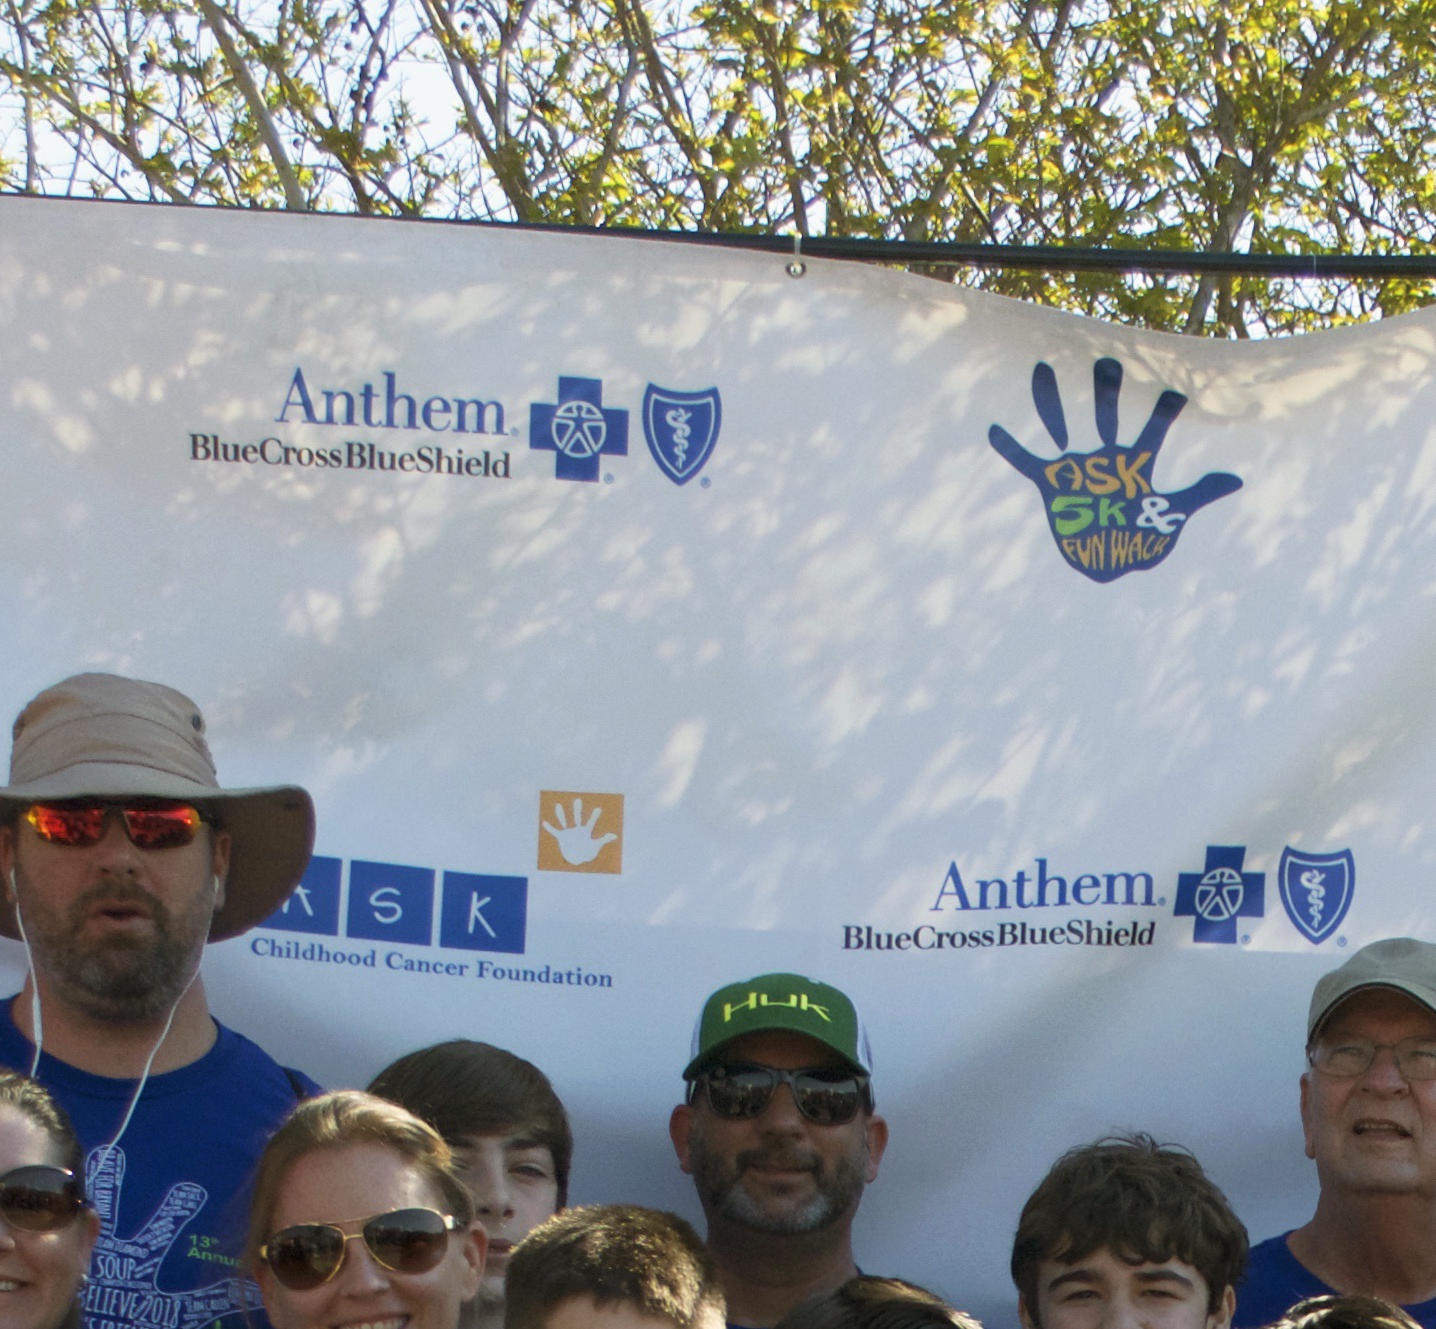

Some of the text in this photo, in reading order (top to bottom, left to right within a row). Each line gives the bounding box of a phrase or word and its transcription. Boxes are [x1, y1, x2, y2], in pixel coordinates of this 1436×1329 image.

[274, 366, 509, 436] Anthem
[1044, 451, 1152, 499] ASK
[1062, 530, 1105, 570] FUN
[929, 858, 1157, 912] Anthem
[250, 937, 613, 987] Childhood Cancer Foundation
[96, 1255, 137, 1280] SOUP
[141, 1295, 181, 1329] 2018
